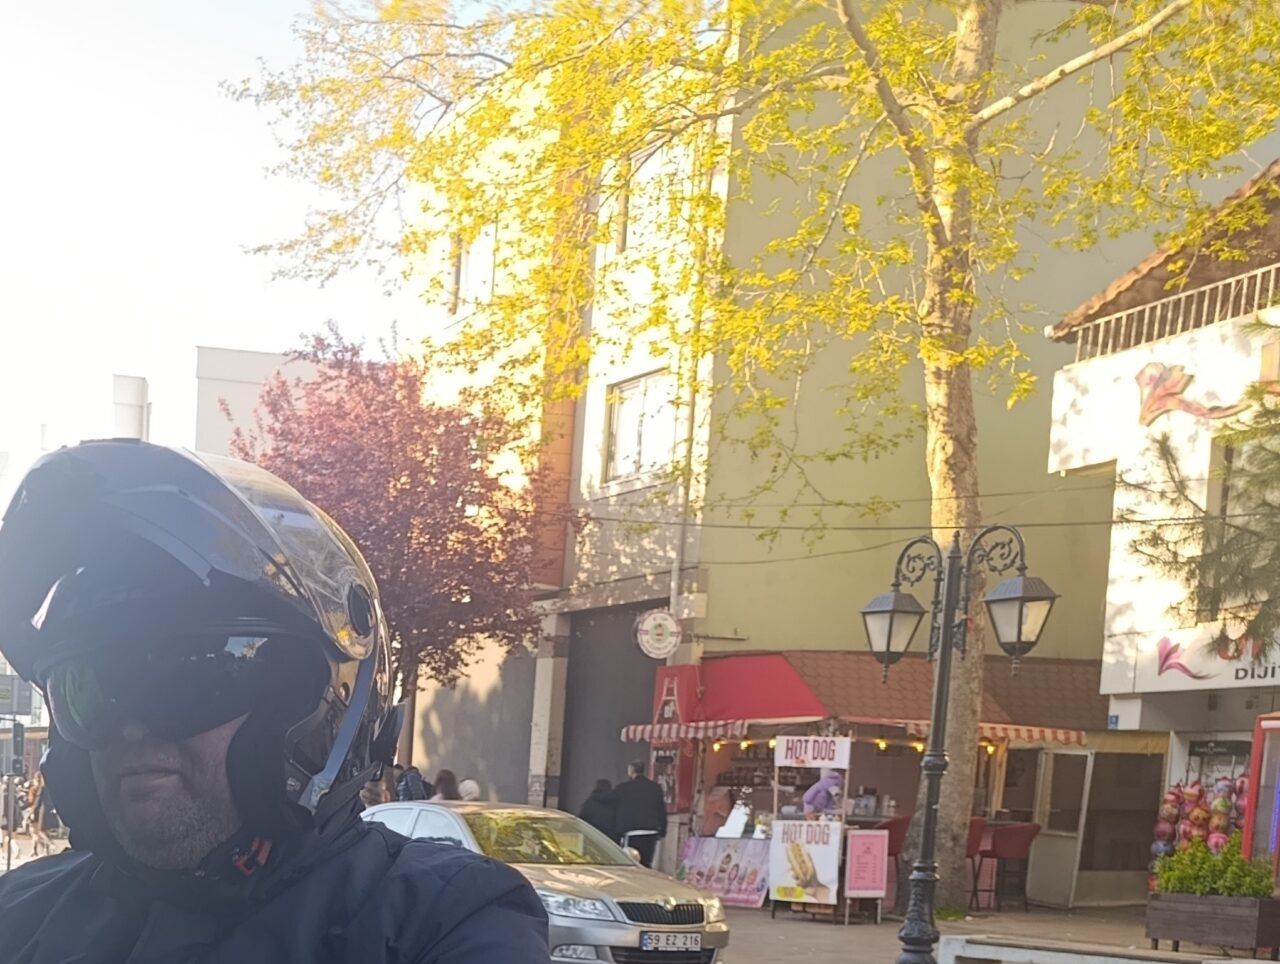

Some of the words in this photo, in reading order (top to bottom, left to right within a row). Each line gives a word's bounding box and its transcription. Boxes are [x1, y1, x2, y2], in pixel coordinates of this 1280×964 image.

[1235, 661, 1280, 680] DİJİ
[785, 739, 809, 760] HOT
[812, 740, 836, 761] DOG
[782, 823, 803, 844] HOT
[806, 824, 830, 845] DOG
[665, 934, 677, 946] EZ
[682, 935, 700, 946] 216
